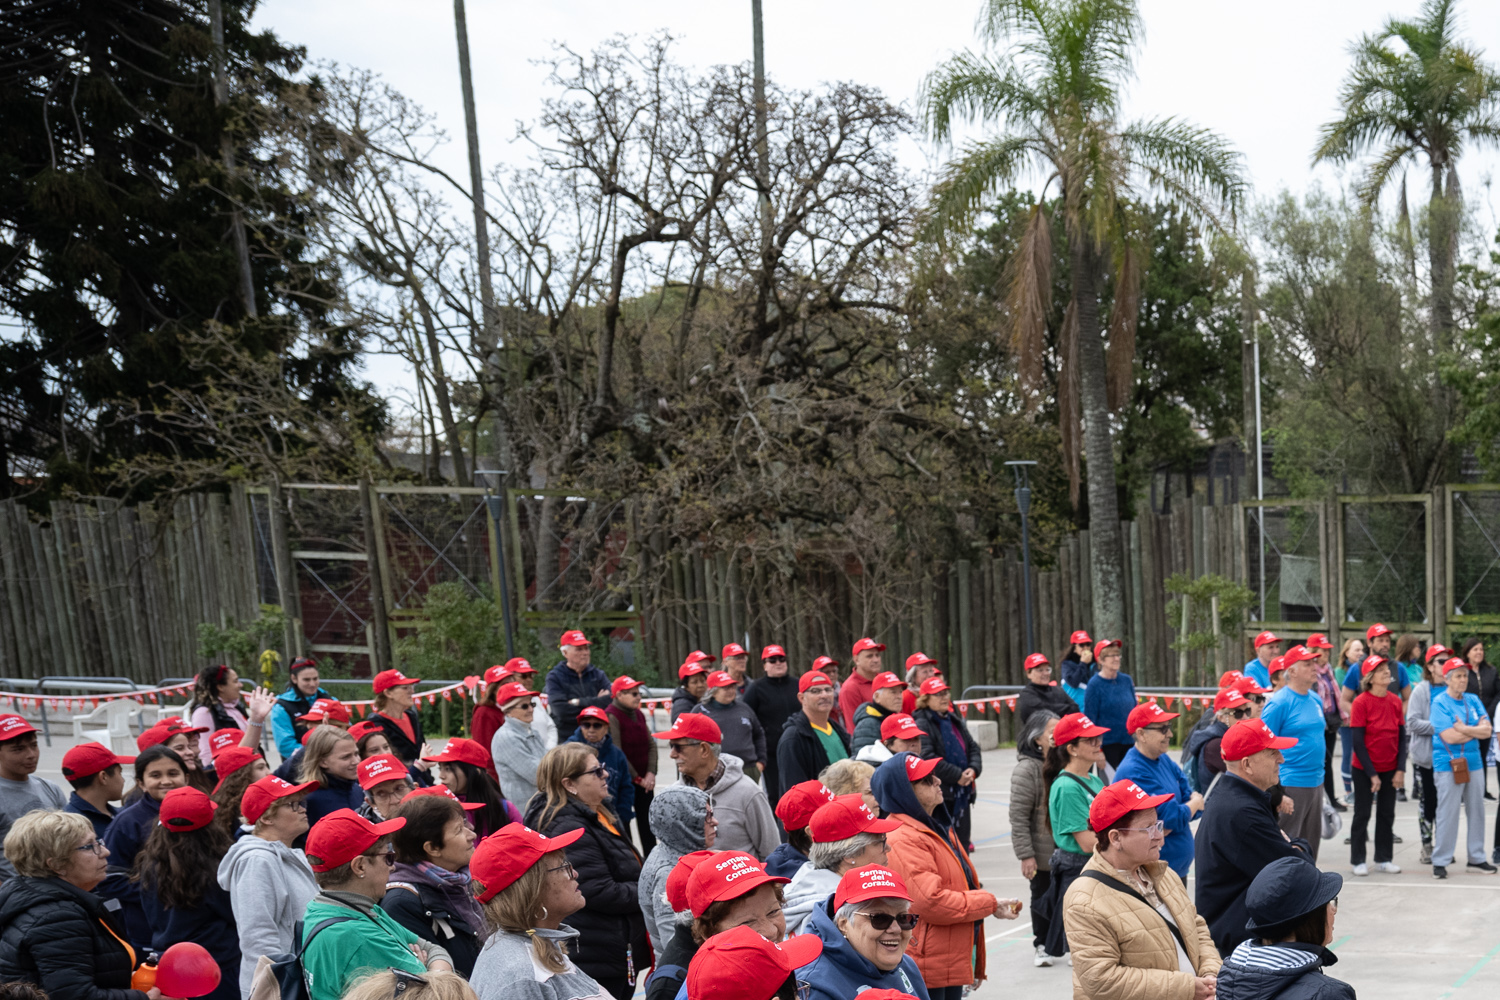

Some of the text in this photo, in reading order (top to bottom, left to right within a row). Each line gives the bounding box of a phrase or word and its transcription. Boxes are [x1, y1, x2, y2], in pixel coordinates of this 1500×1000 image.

[715, 856, 750, 871] Semana
[732, 860, 747, 871] del
[725, 865, 761, 882] Corazón
[859, 869, 893, 878] Semana
[862, 880, 896, 889] Corazón
